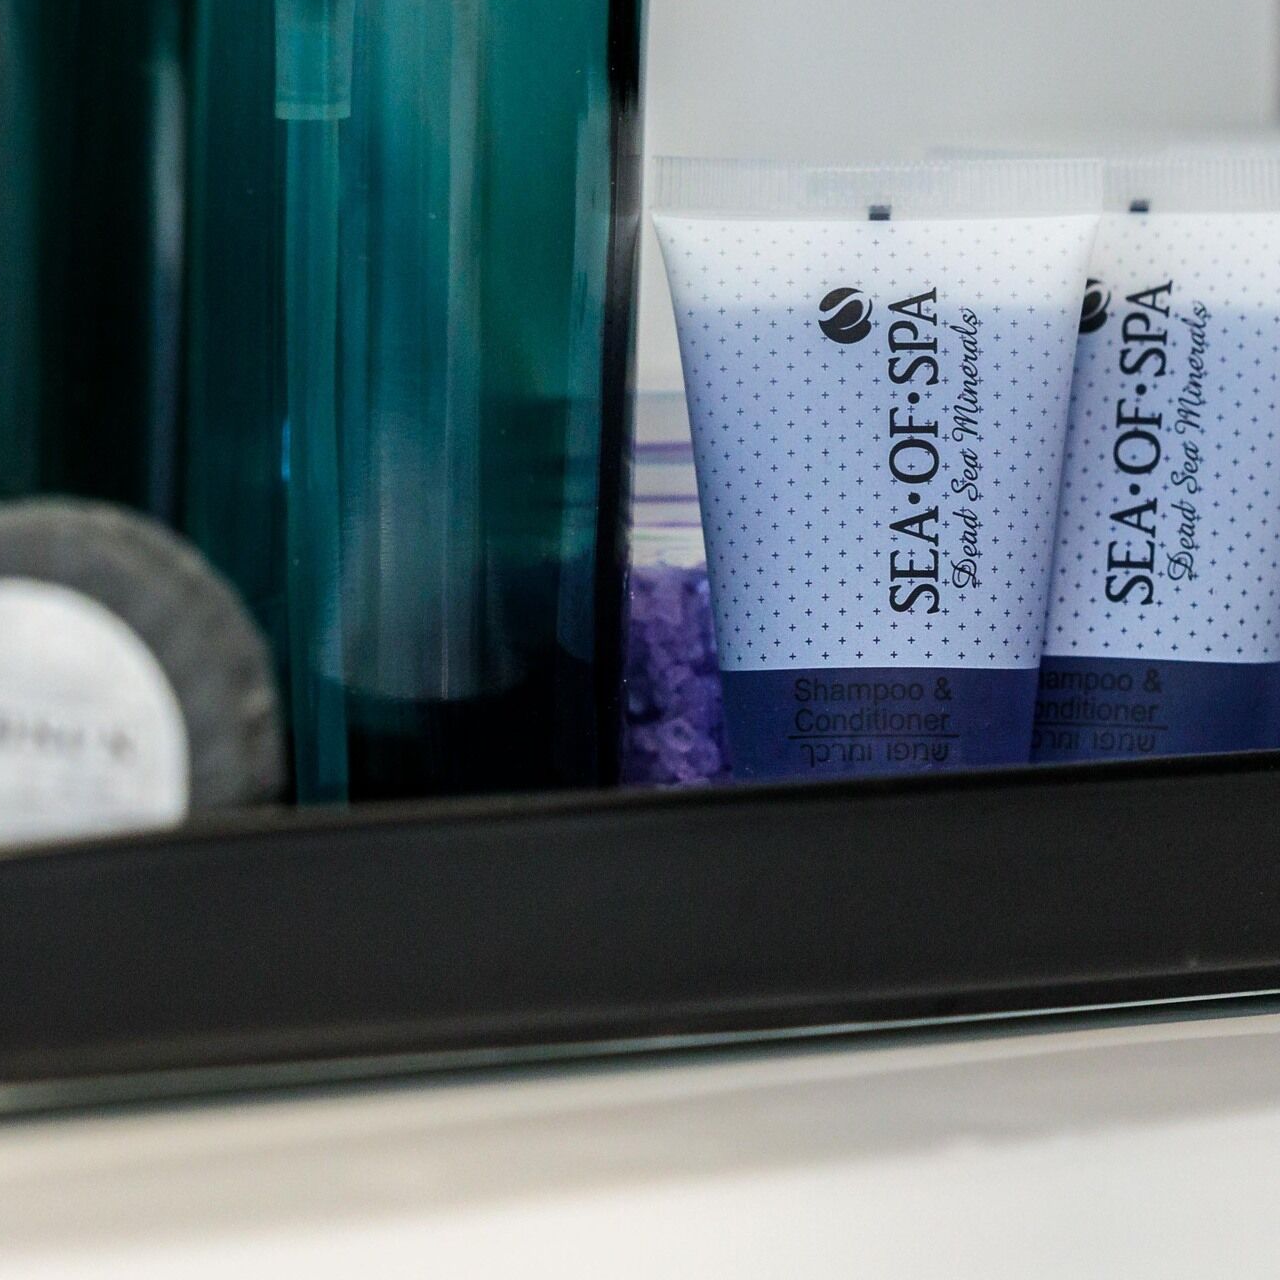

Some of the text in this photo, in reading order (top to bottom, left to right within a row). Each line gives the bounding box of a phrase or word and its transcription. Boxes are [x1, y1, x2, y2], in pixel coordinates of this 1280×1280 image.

[950, 306, 979, 589] Dead Sea Minerals
[1166, 300, 1209, 581] Dead Sea Minerals
[793, 676, 953, 705] Shampoo &
[1038, 667, 1162, 696] ampoo &
[793, 707, 950, 733] Conditioner
[1034, 696, 1159, 723] onditioner
[886, 741, 949, 762] שמפו
